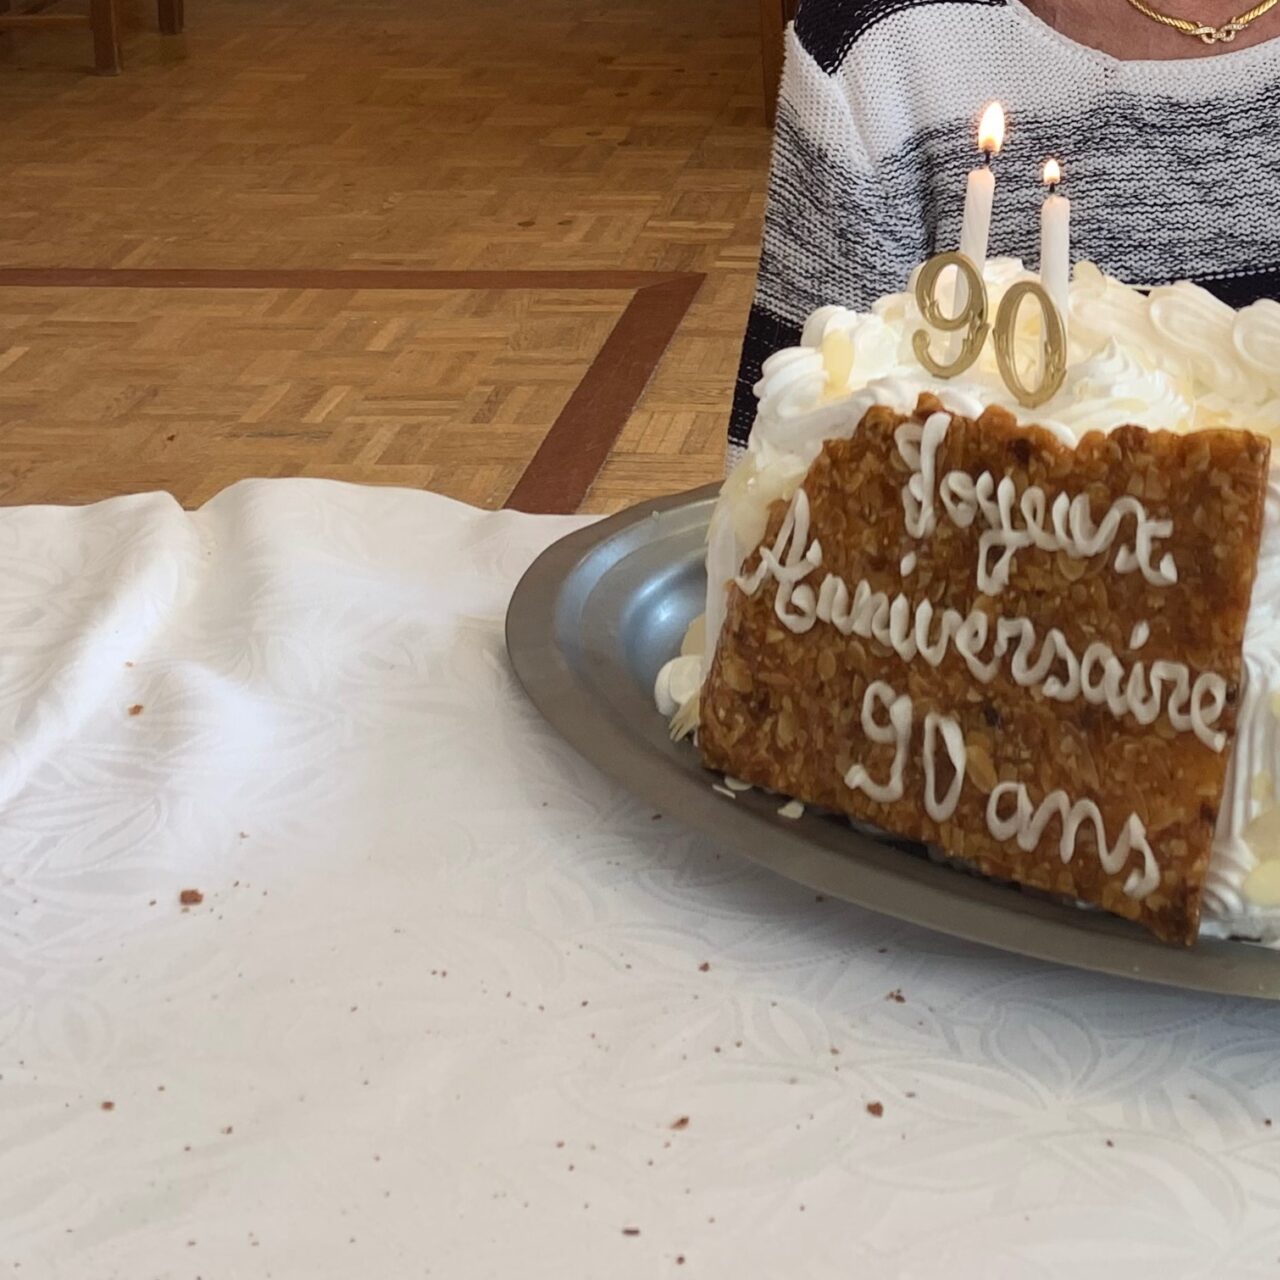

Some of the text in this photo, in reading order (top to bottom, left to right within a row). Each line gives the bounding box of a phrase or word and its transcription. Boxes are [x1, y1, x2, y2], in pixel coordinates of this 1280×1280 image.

[912, 252, 1067, 410] 90
[893, 411, 1178, 596] Joyeux
[735, 487, 1228, 752] Anniversaire
[844, 680, 1160, 900] 90 ans
